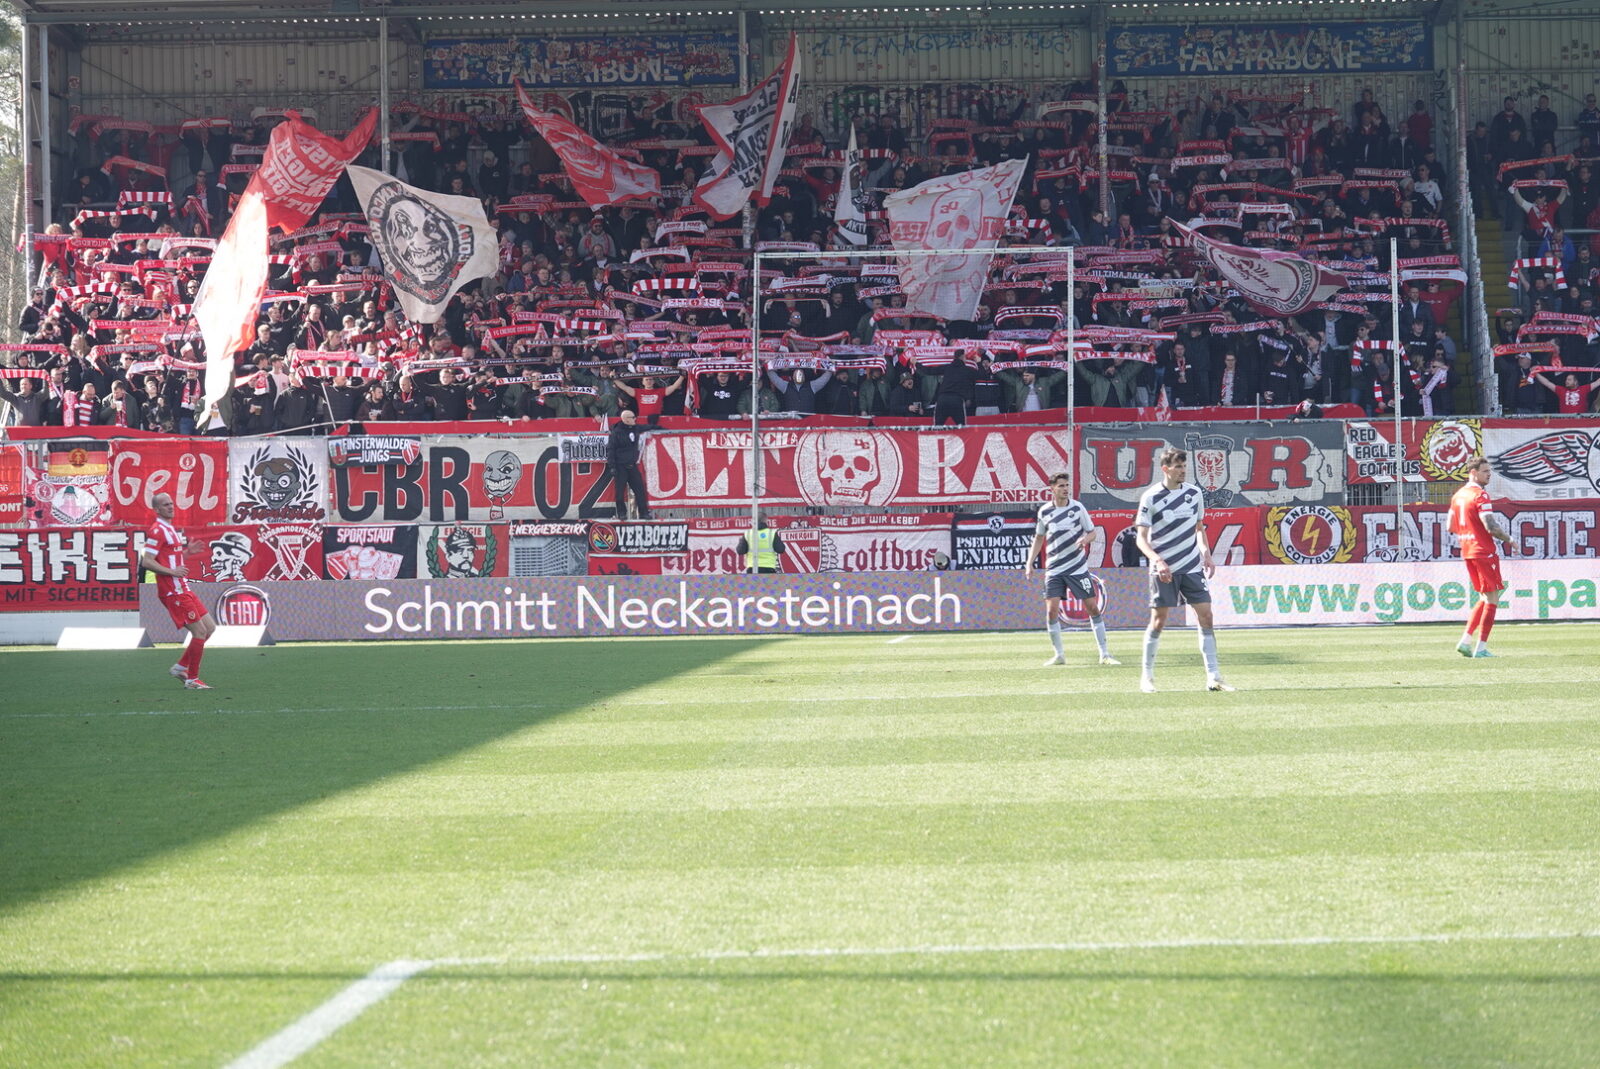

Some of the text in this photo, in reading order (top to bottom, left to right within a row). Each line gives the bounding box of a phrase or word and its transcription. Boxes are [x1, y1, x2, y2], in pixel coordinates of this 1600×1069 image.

[1350, 428, 1377, 441] RED
[359, 451, 390, 464] JUNGS
[112, 450, 219, 511] Geil
[1535, 487, 1592, 498] SEIT
[820, 516, 920, 526] SACHE DIE WIR LEBEN
[1284, 505, 1338, 526] ENERGIE
[337, 526, 395, 544] SPORTSTADT
[509, 522, 588, 536] ENERGIEBEZIRK
[616, 524, 688, 546] VERBOTEN
[1285, 543, 1338, 565] COTTBUS
[1079, 578, 1092, 589] 19
[6, 588, 37, 602] MIT
[229, 600, 260, 625] FIAT
[364, 576, 961, 634] Schmitt Neckarsteinach
